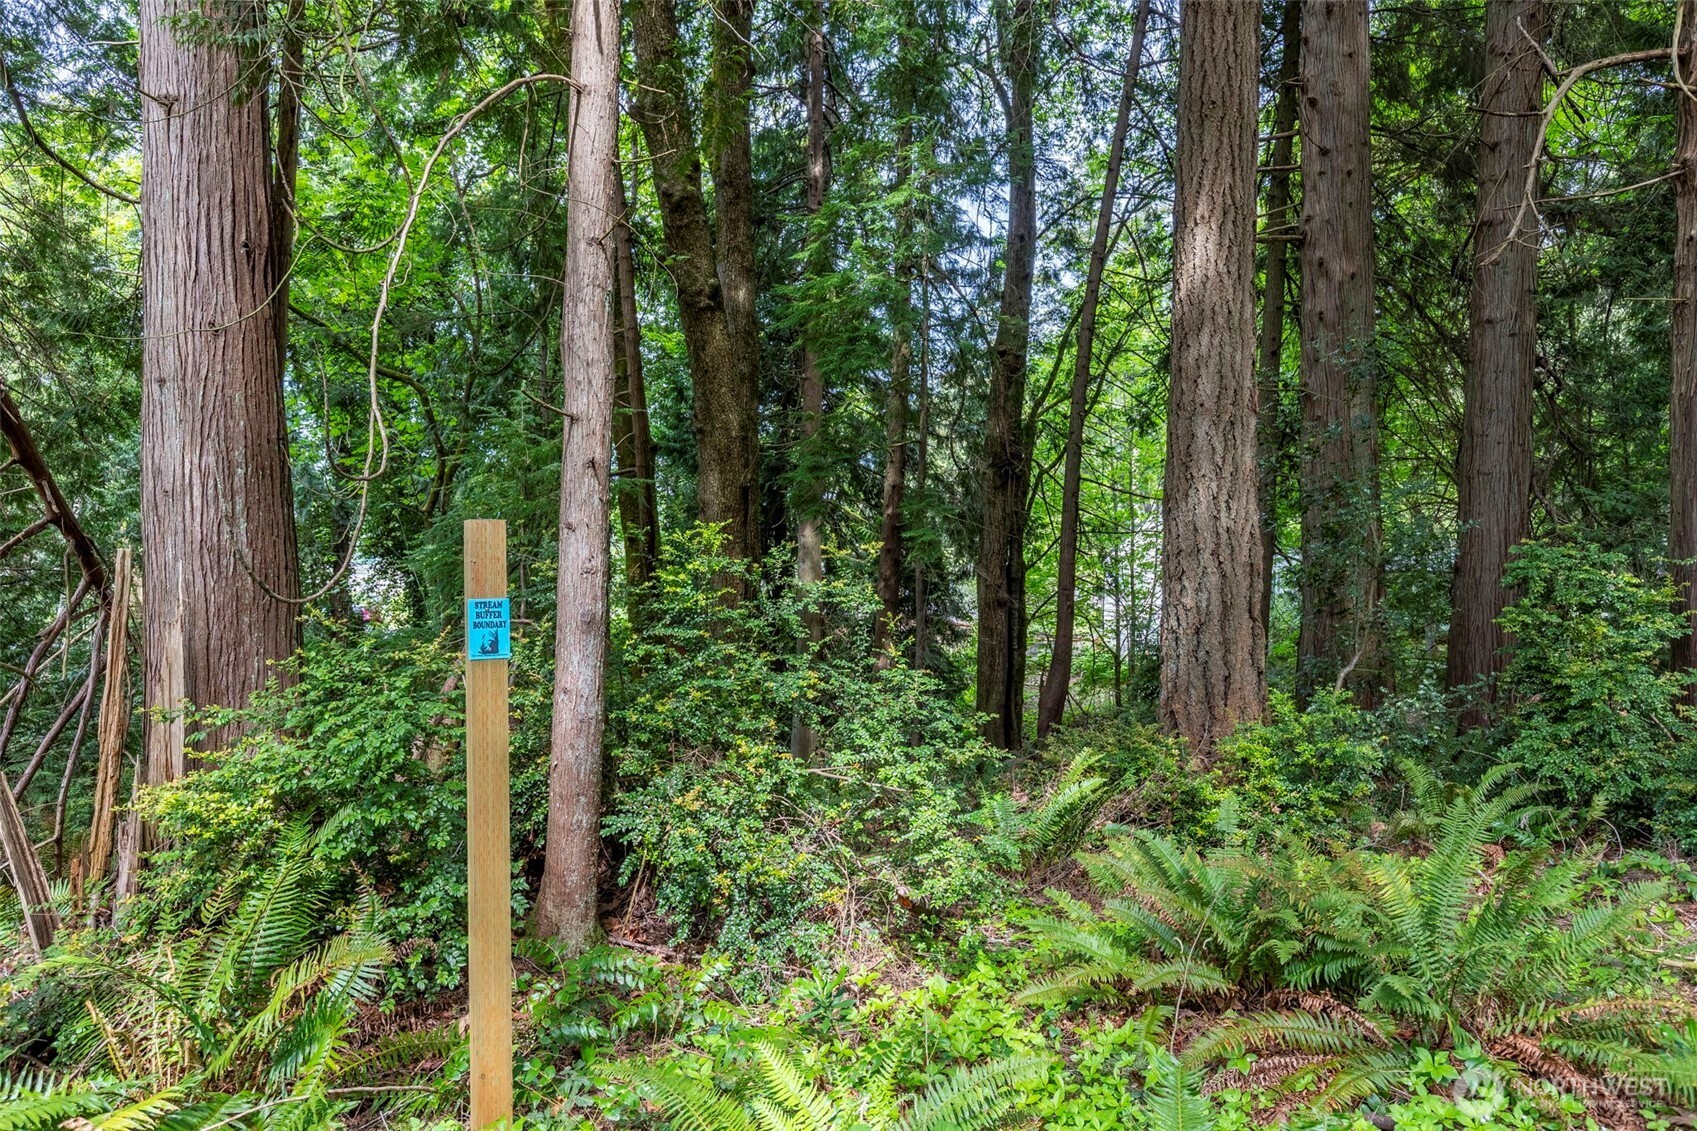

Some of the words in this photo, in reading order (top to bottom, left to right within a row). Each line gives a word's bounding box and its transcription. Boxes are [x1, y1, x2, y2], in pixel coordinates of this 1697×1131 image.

[474, 601, 502, 609] STREAM
[476, 610, 502, 619] BUFFER
[472, 620, 507, 629] BOUNDARY
